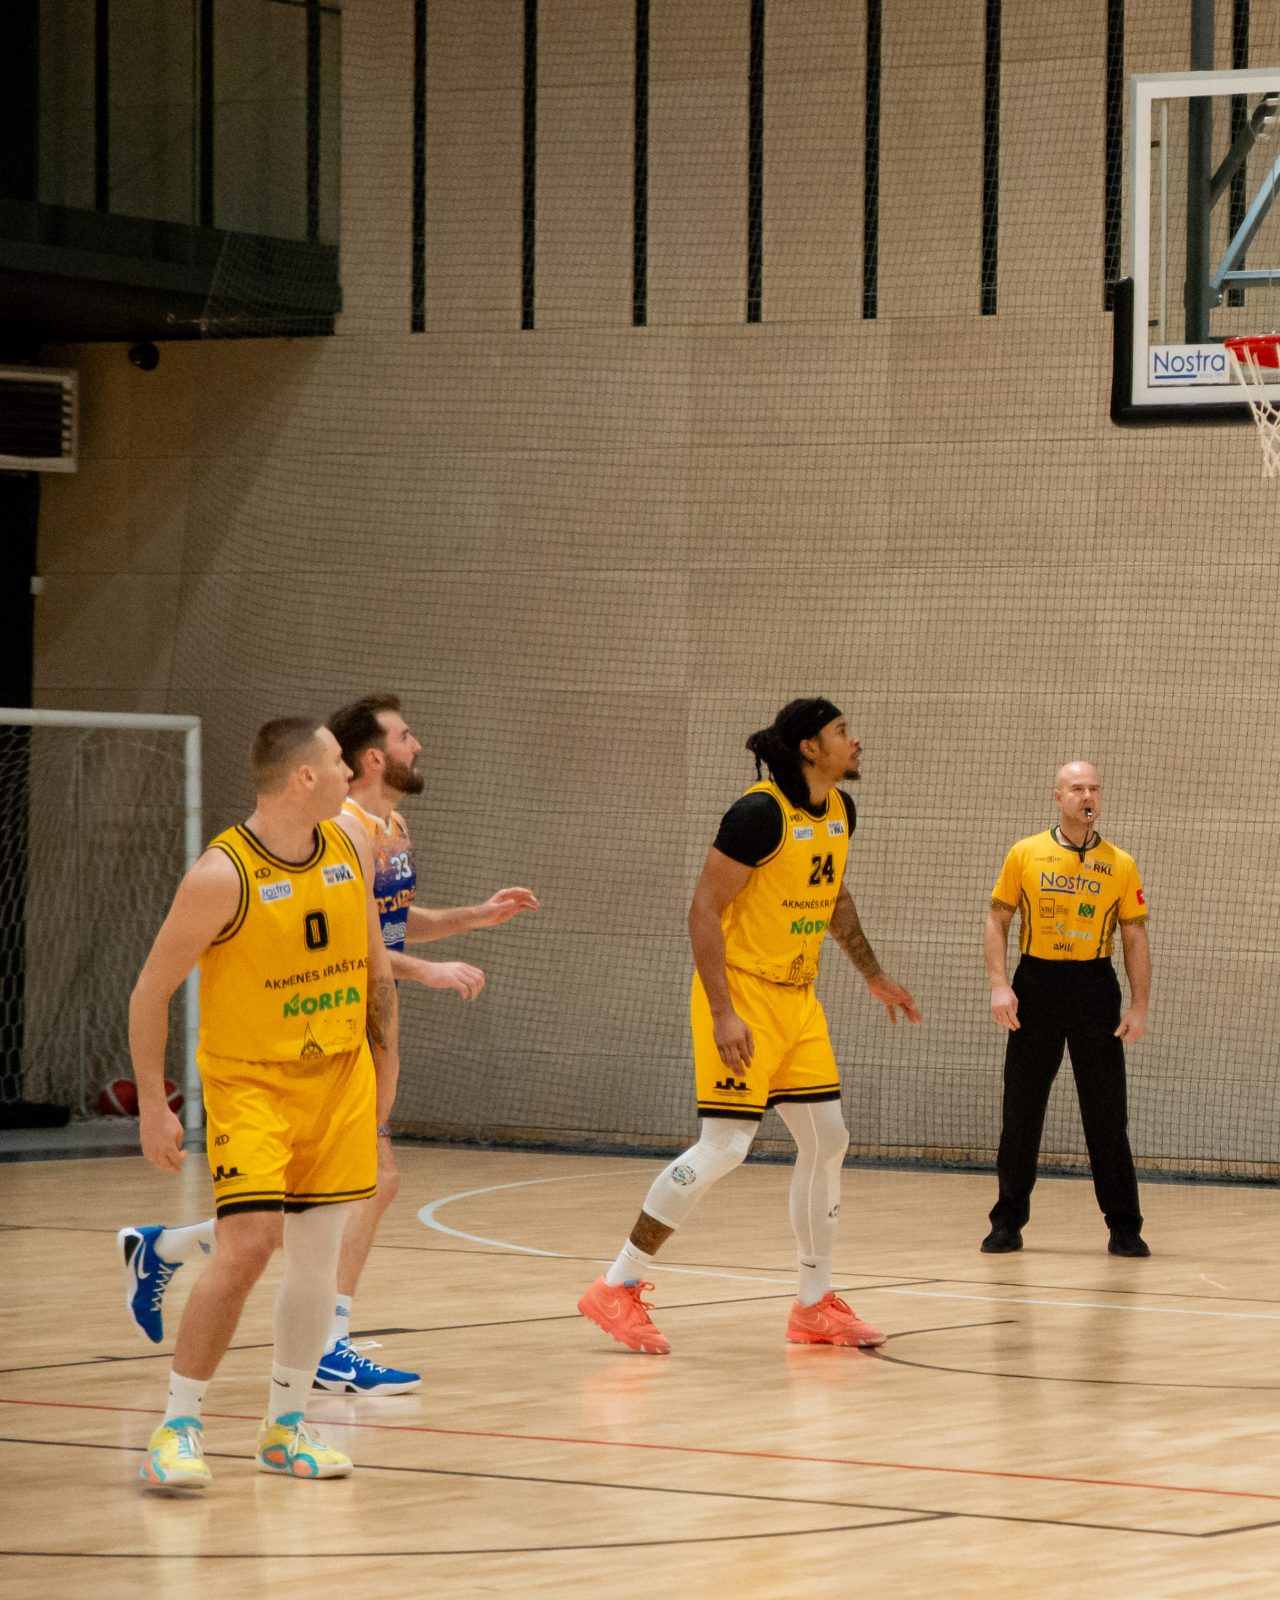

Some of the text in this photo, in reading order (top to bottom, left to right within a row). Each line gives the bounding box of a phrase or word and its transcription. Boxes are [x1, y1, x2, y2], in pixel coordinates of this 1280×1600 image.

[1154, 350, 1225, 373] Nostra
[808, 852, 835, 886] 24
[1093, 863, 1113, 876] RKL
[1041, 871, 1101, 894] Nostra
[304, 910, 329, 952] 0
[264, 970, 320, 989] AKMENĖS
[283, 987, 361, 1019] NORFA
